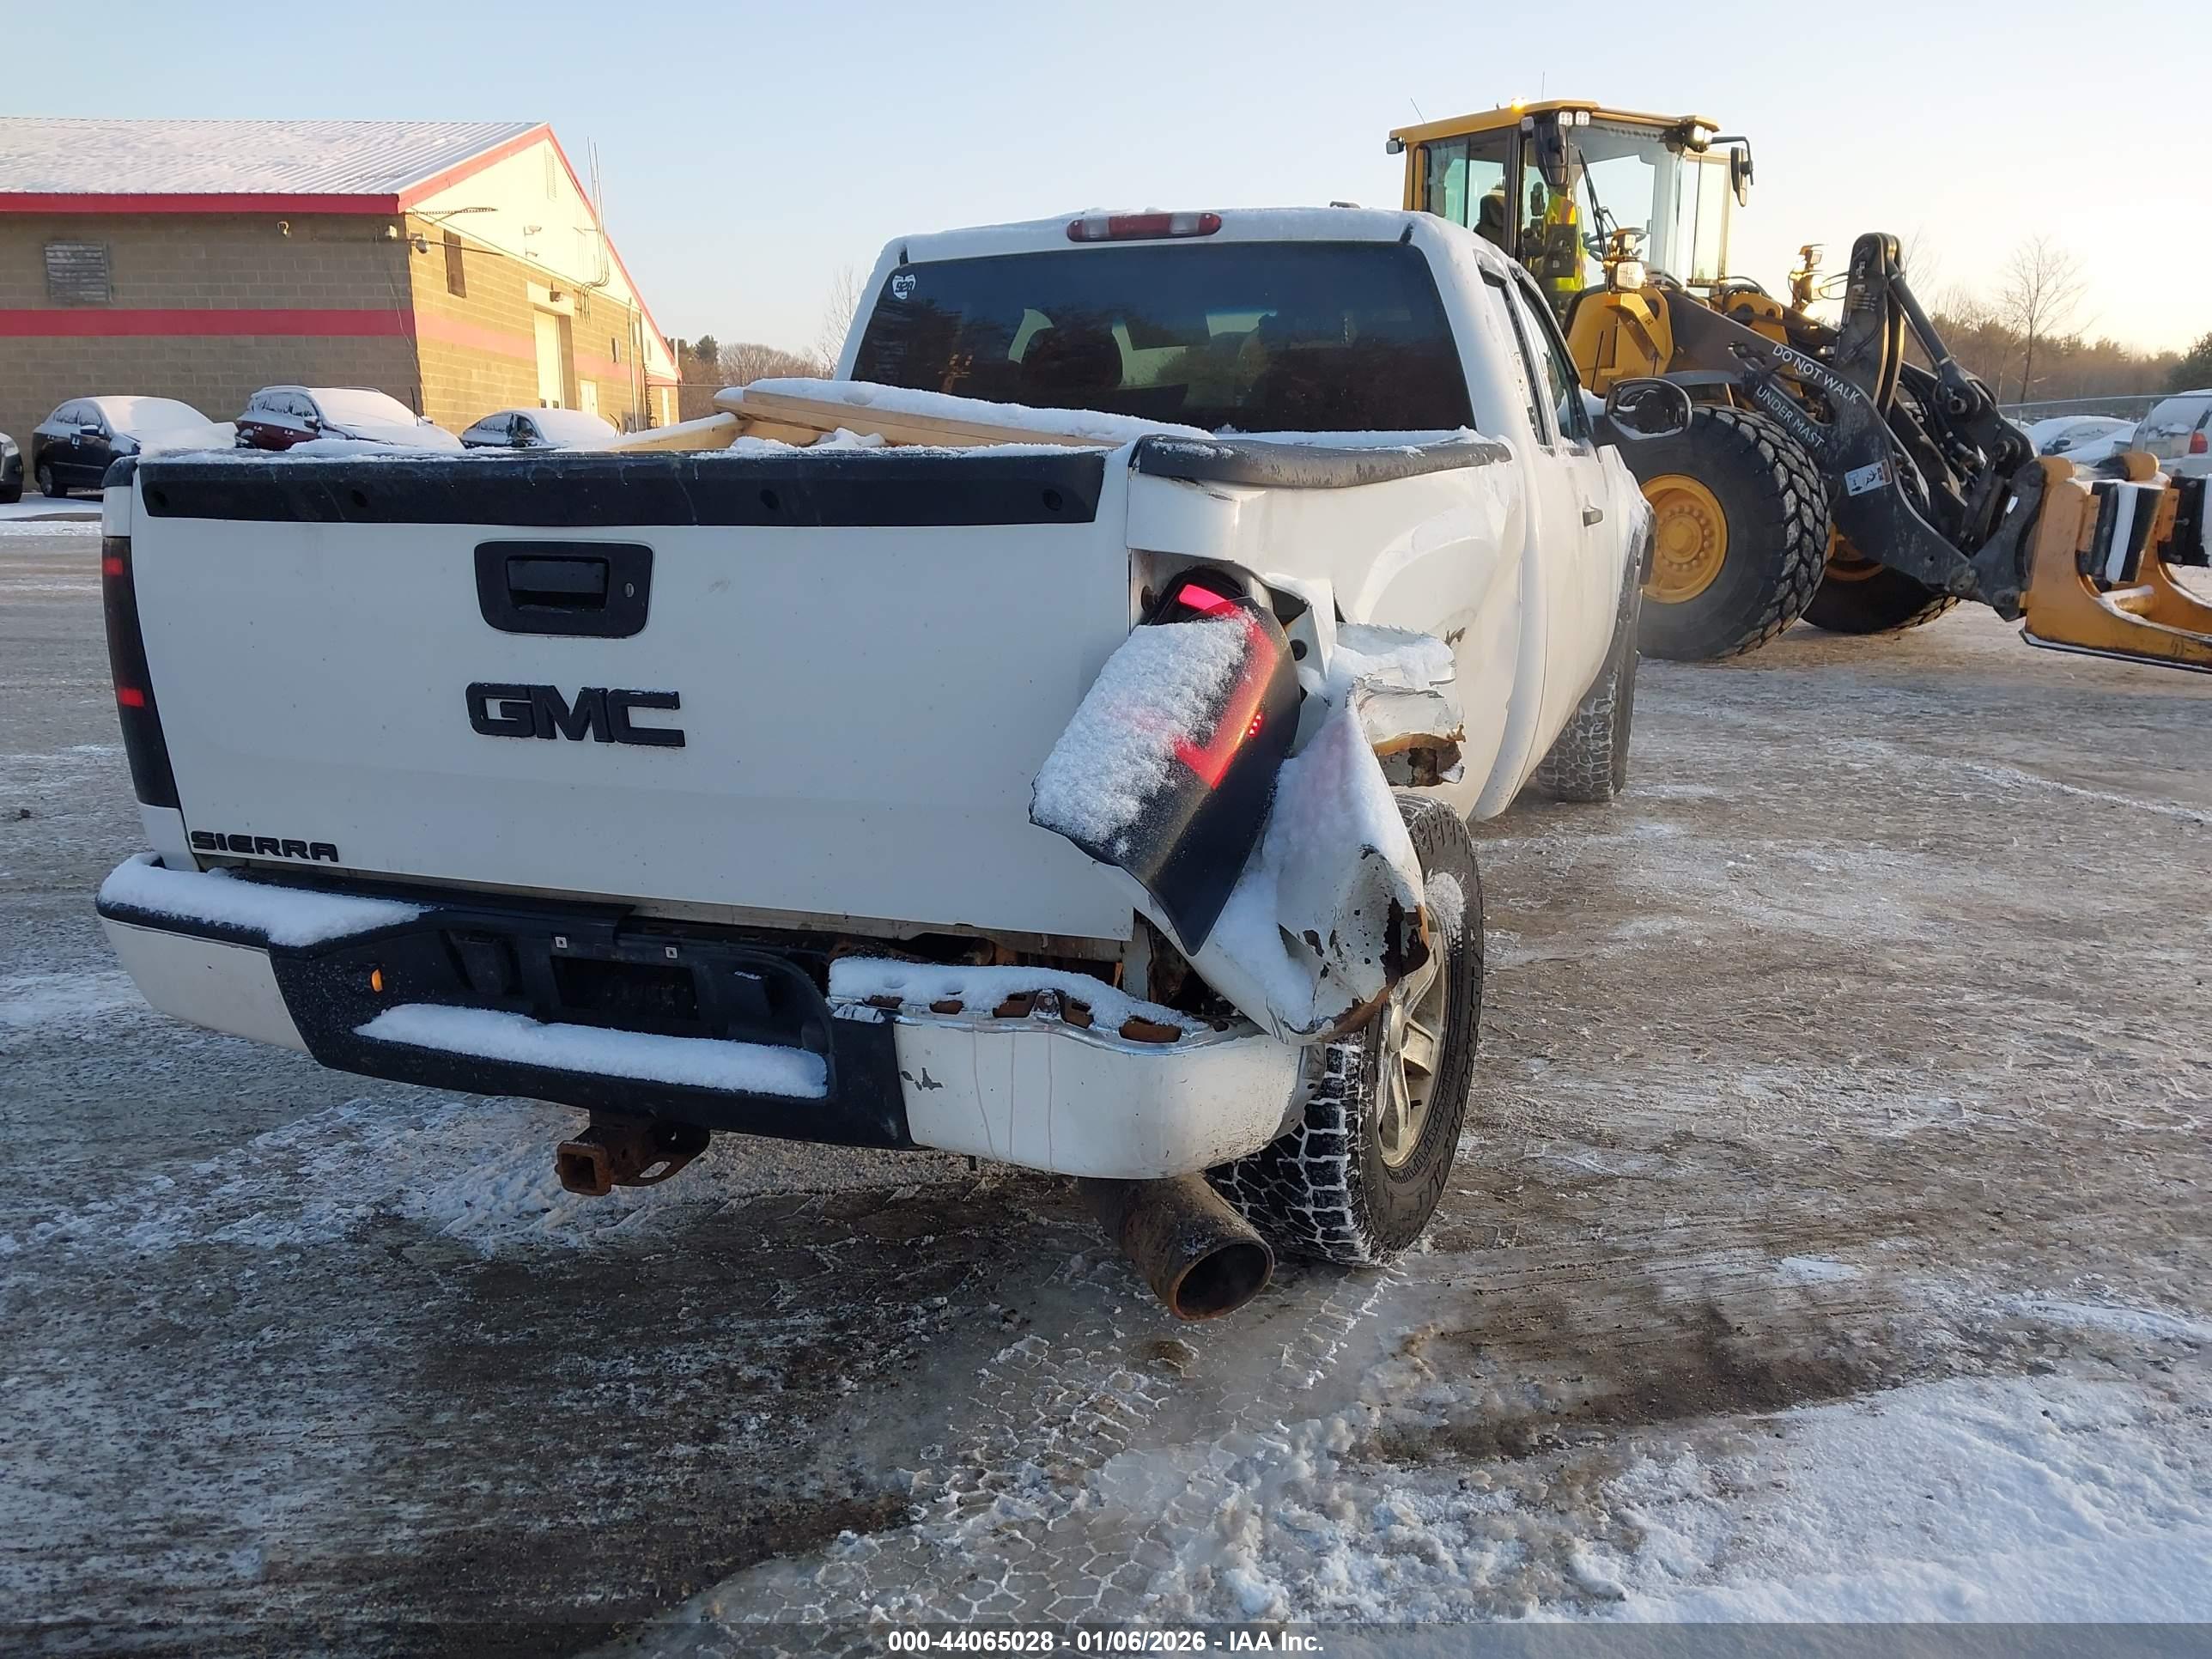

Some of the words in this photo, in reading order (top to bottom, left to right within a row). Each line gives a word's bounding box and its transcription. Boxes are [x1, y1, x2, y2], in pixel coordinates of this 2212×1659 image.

[1772, 344, 1793, 363] DO
[1793, 356, 1823, 380] NOT
[1824, 374, 1861, 404] WALK
[1756, 384, 1794, 422] UNDER
[1793, 416, 1825, 448] MAST
[465, 681, 686, 747] GMC
[191, 830, 339, 862] SIERRA
